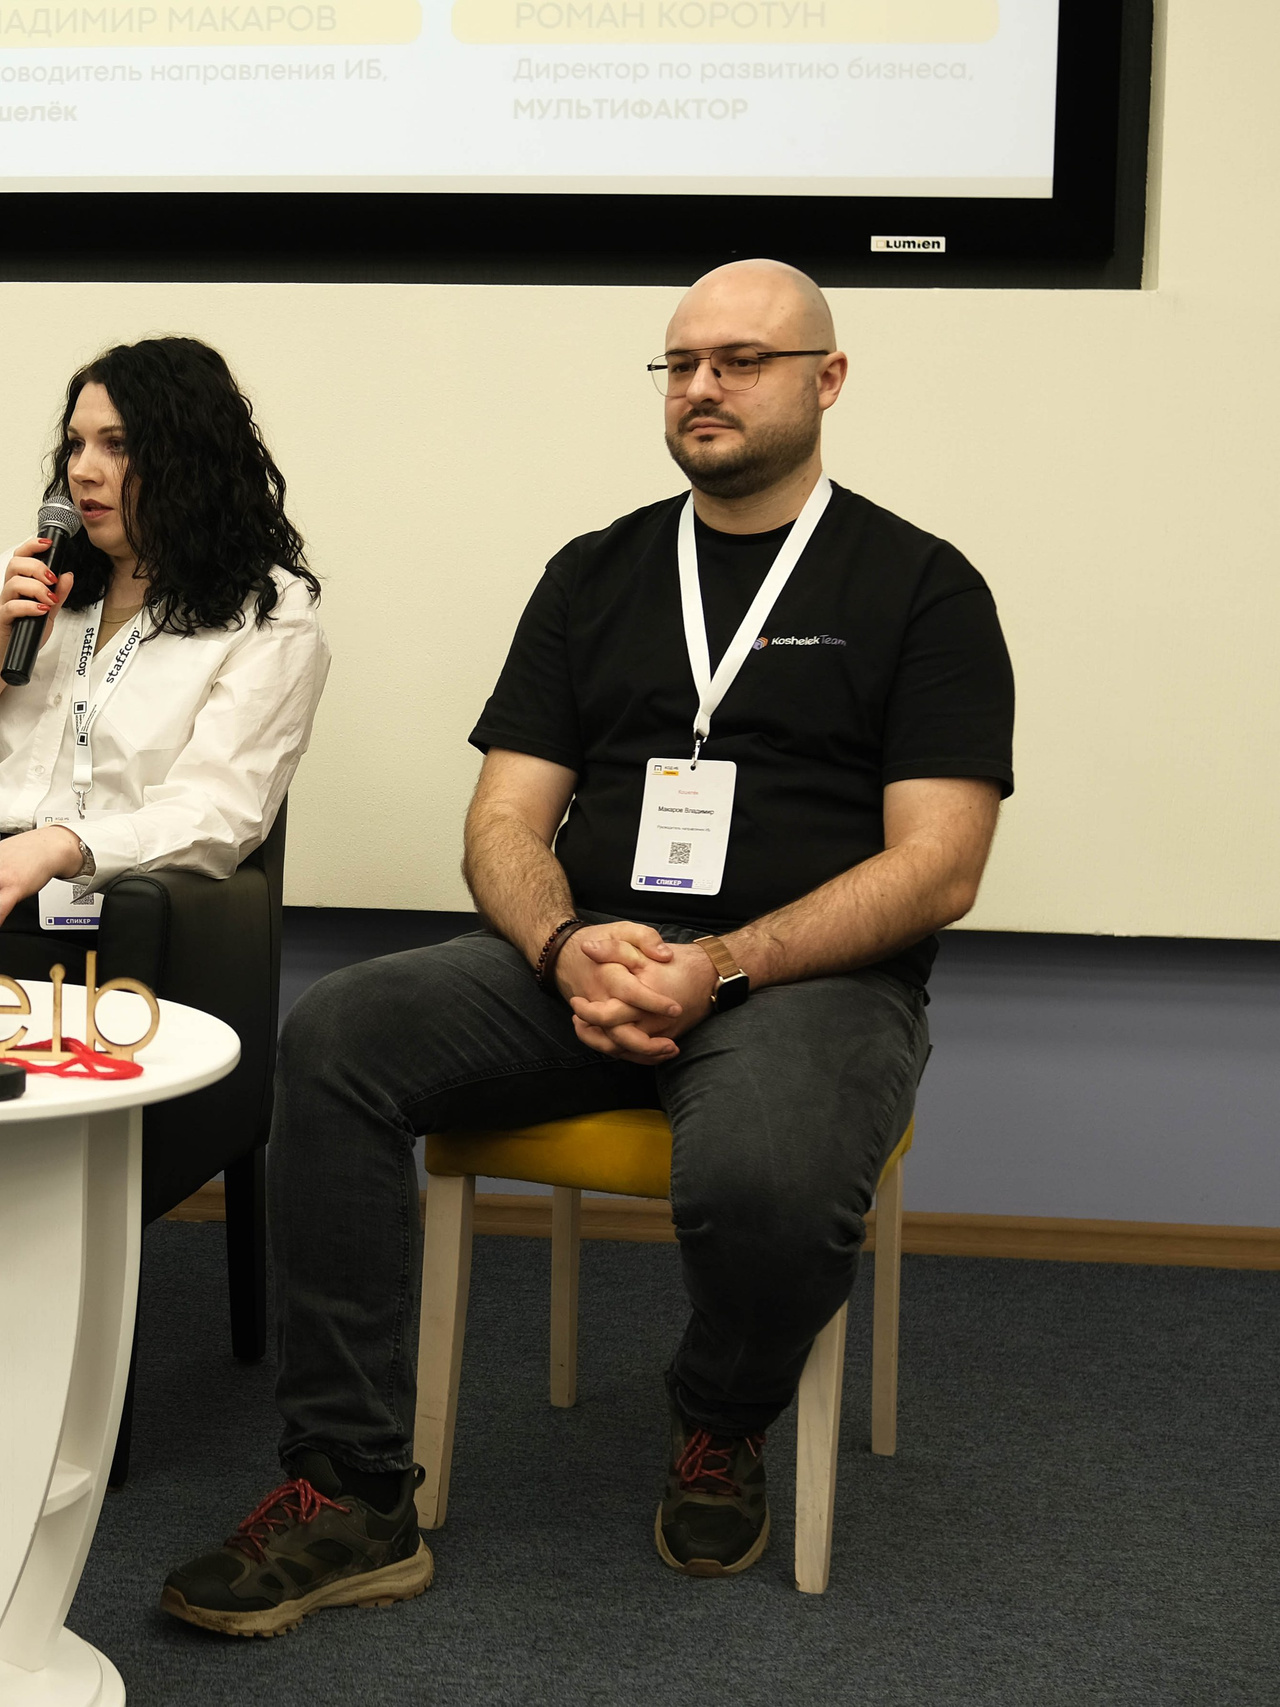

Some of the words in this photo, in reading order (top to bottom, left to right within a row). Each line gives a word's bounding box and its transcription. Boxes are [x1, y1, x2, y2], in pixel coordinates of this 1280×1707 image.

[168, 5, 338, 33] МАКАРОВ
[515, 1, 645, 30] РОМАН
[657, 1, 827, 29] КОРОТУН
[151, 61, 335, 85] направления
[344, 58, 388, 82] ИБ,
[513, 58, 650, 84] Директор
[658, 62, 692, 80] по
[700, 60, 840, 83] развитию
[847, 57, 975, 82] бизнеса,
[513, 98, 749, 121] МУЛЬТИФАКТОР
[885, 239, 941, 250] Lumien
[76, 627, 95, 677] staffcop
[106, 628, 141, 684] staffcop
[656, 878, 683, 886] СПИКЕР
